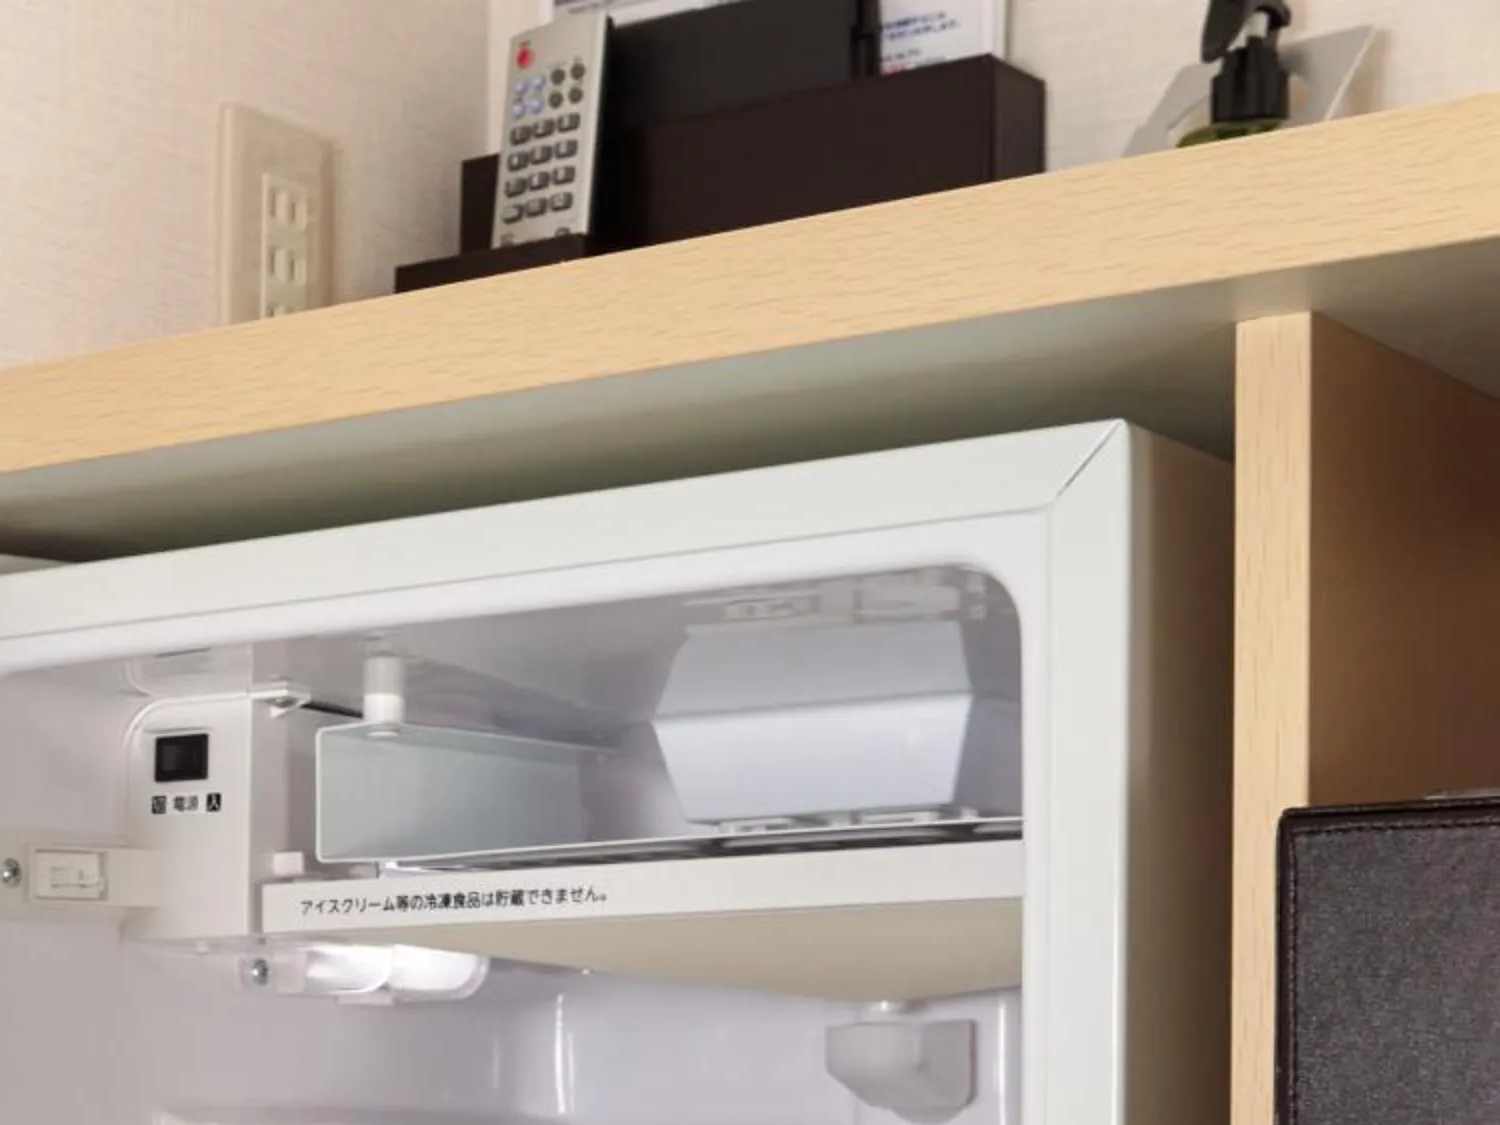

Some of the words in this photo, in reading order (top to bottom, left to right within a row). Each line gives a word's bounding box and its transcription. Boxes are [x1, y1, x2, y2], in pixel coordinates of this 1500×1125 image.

[300, 885, 607, 917] アイスクリーム等の冷凍食品は貯蔵できません。
